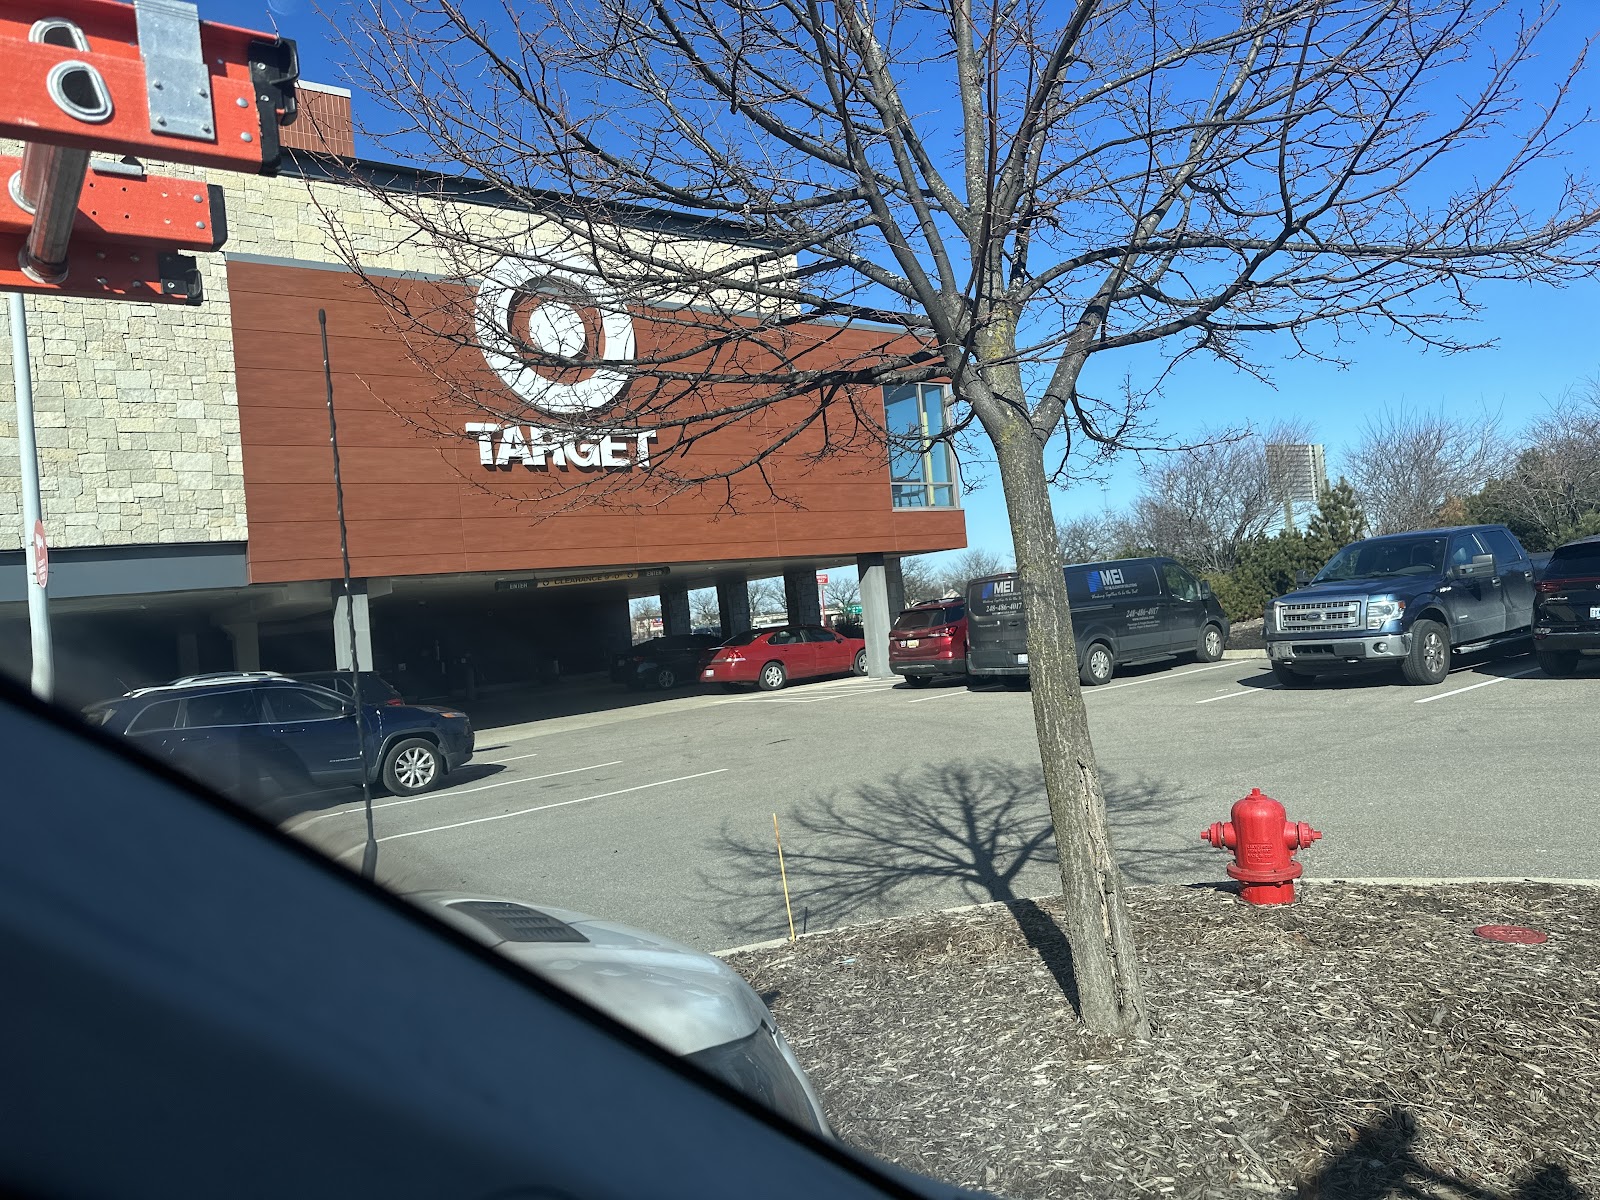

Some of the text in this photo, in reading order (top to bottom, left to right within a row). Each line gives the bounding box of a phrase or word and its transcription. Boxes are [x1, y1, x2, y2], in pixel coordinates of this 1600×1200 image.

[465, 422, 657, 468] TARGET
[554, 575, 602, 585] CLEARANCE
[1099, 568, 1125, 586] MEI
[993, 580, 1014, 594] MEI
